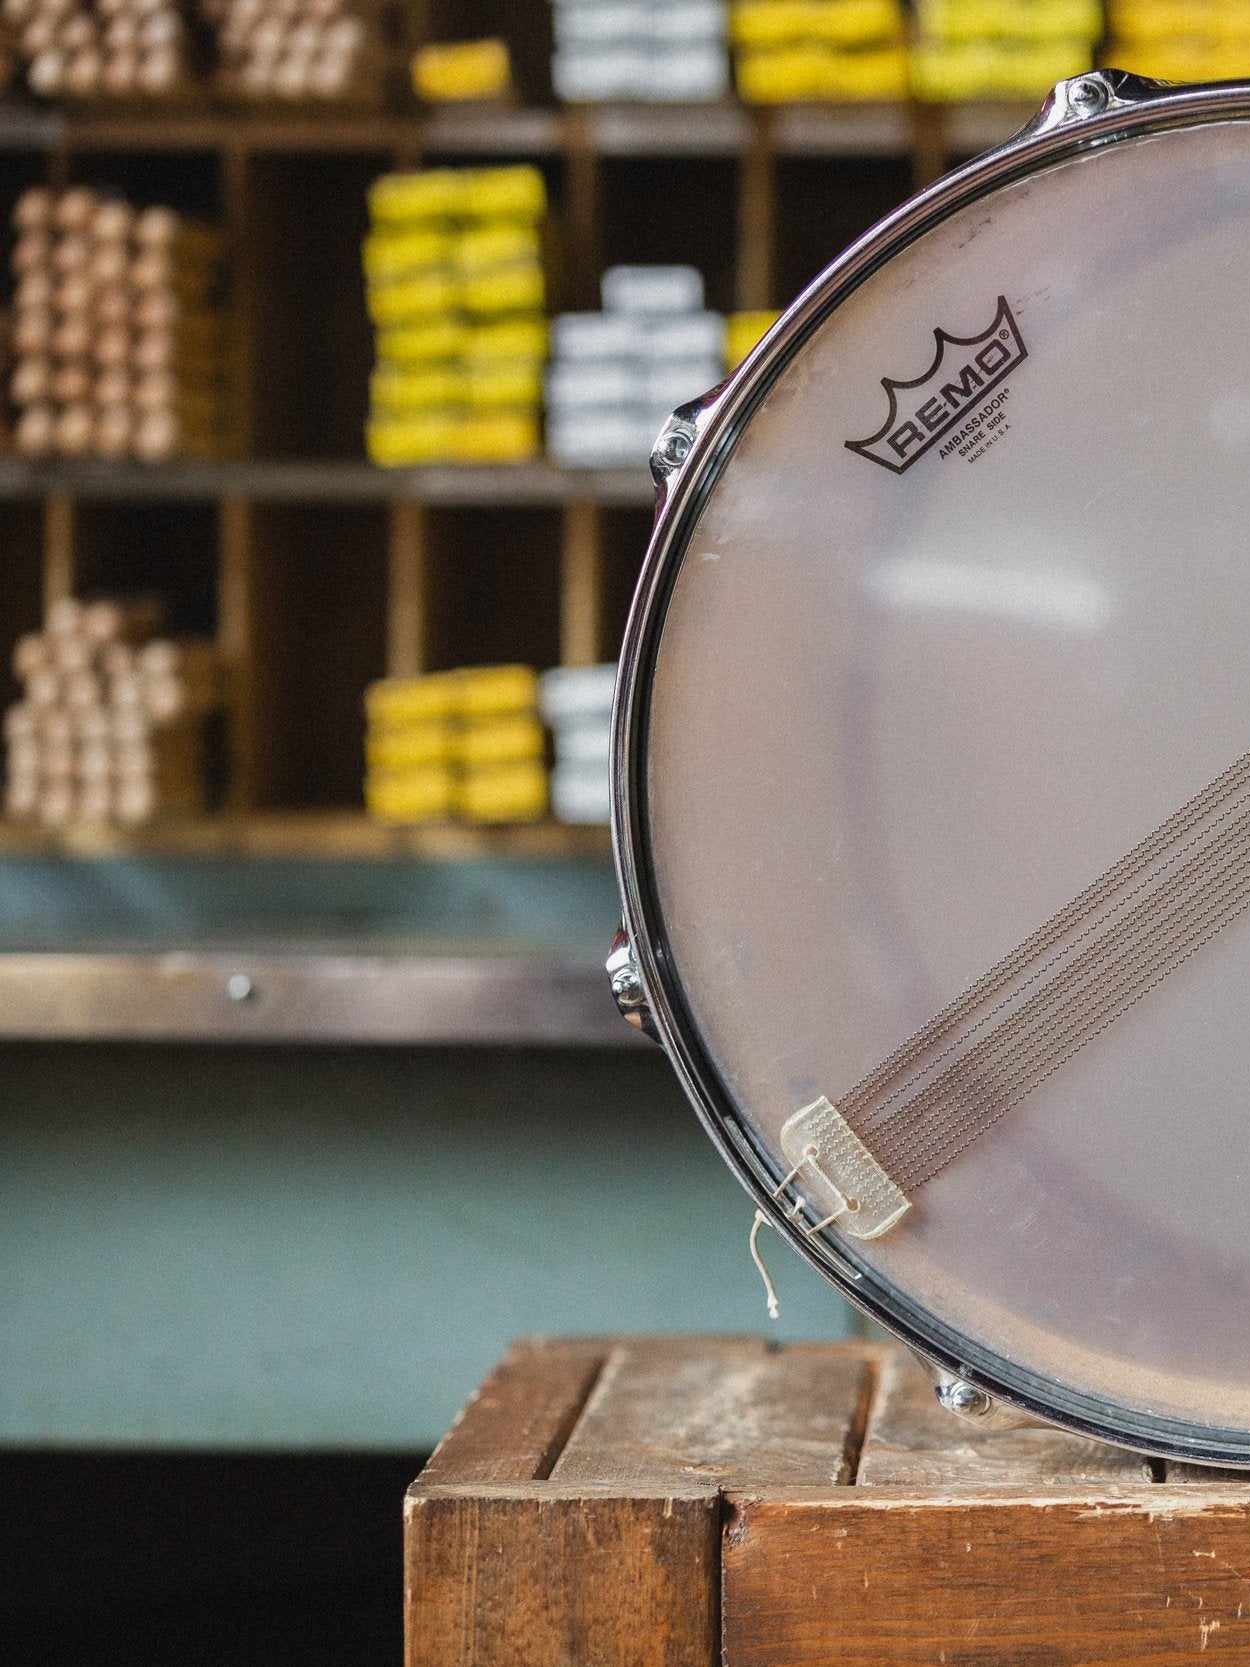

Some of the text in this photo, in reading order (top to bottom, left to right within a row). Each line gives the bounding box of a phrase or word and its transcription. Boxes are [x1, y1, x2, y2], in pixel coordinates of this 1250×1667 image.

[958, 411, 1007, 457] SNARE SIDE
[967, 445, 986, 464] MADE
